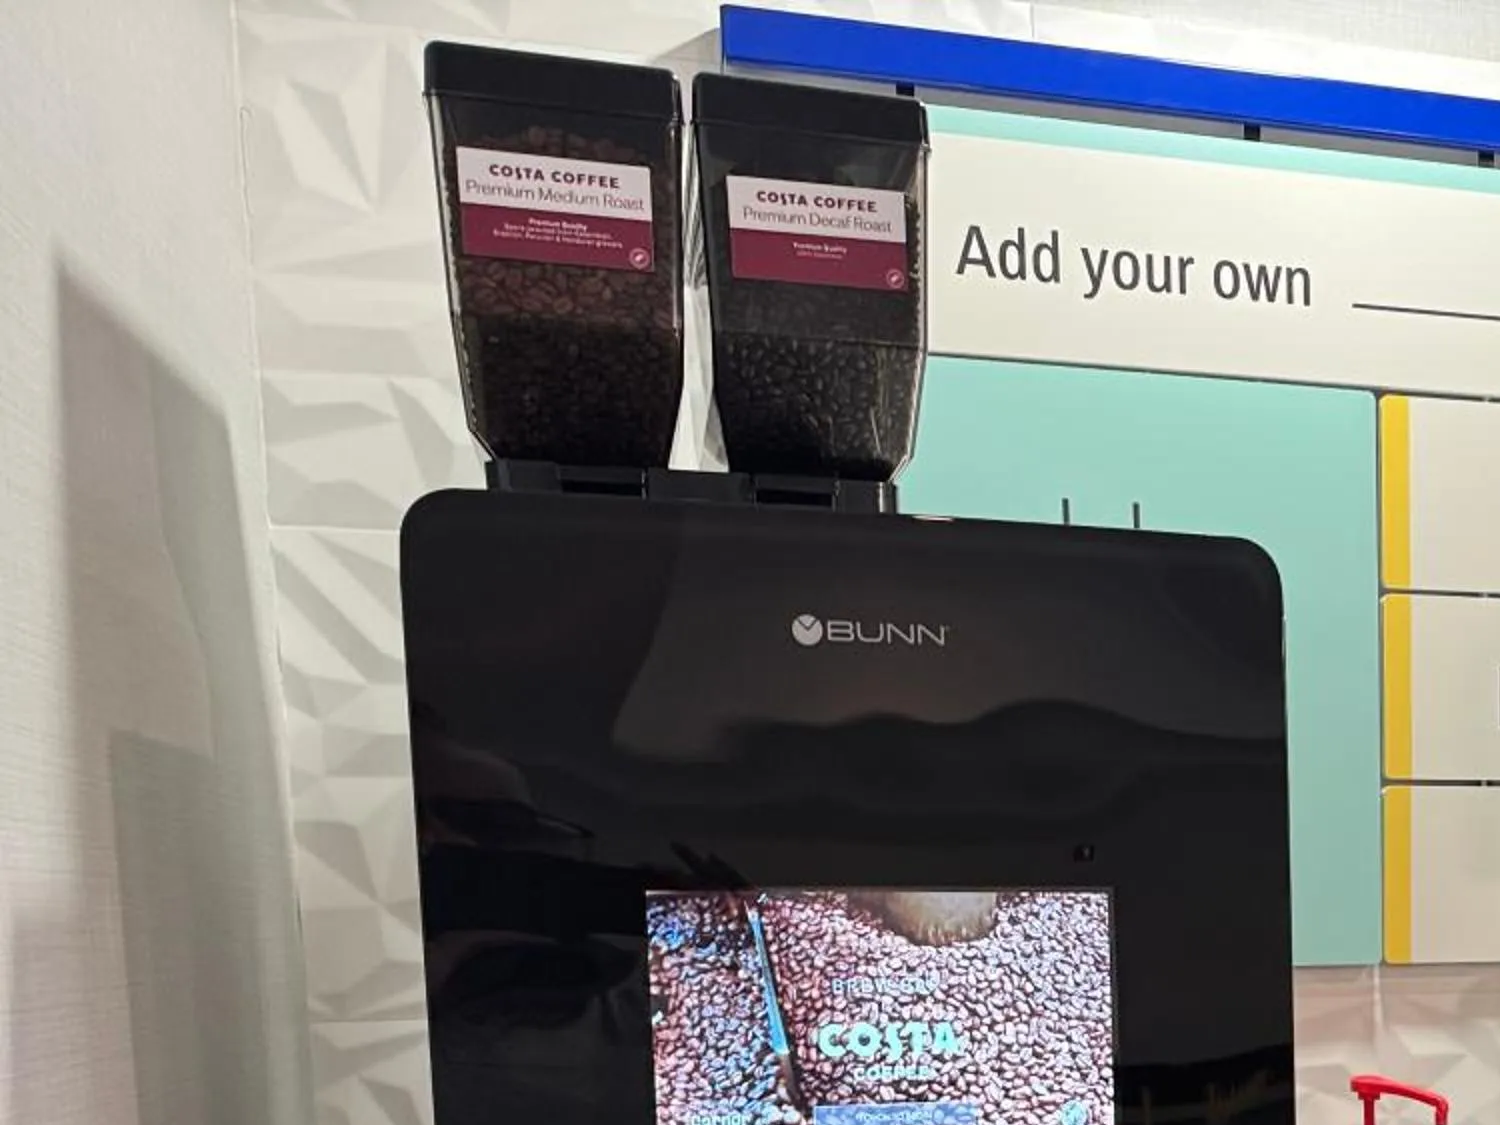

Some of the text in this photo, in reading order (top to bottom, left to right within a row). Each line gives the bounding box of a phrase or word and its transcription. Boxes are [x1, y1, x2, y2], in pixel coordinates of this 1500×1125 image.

[488, 163, 621, 190] COSTA COFFEE
[465, 179, 646, 212] Premium Medium Roast
[757, 190, 878, 213] COSTA COFFEE
[742, 205, 893, 234] Premium Decaf Roast
[955, 224, 1312, 307] Add your own
[826, 618, 946, 647] BUNN
[817, 1021, 963, 1062] COSTA
